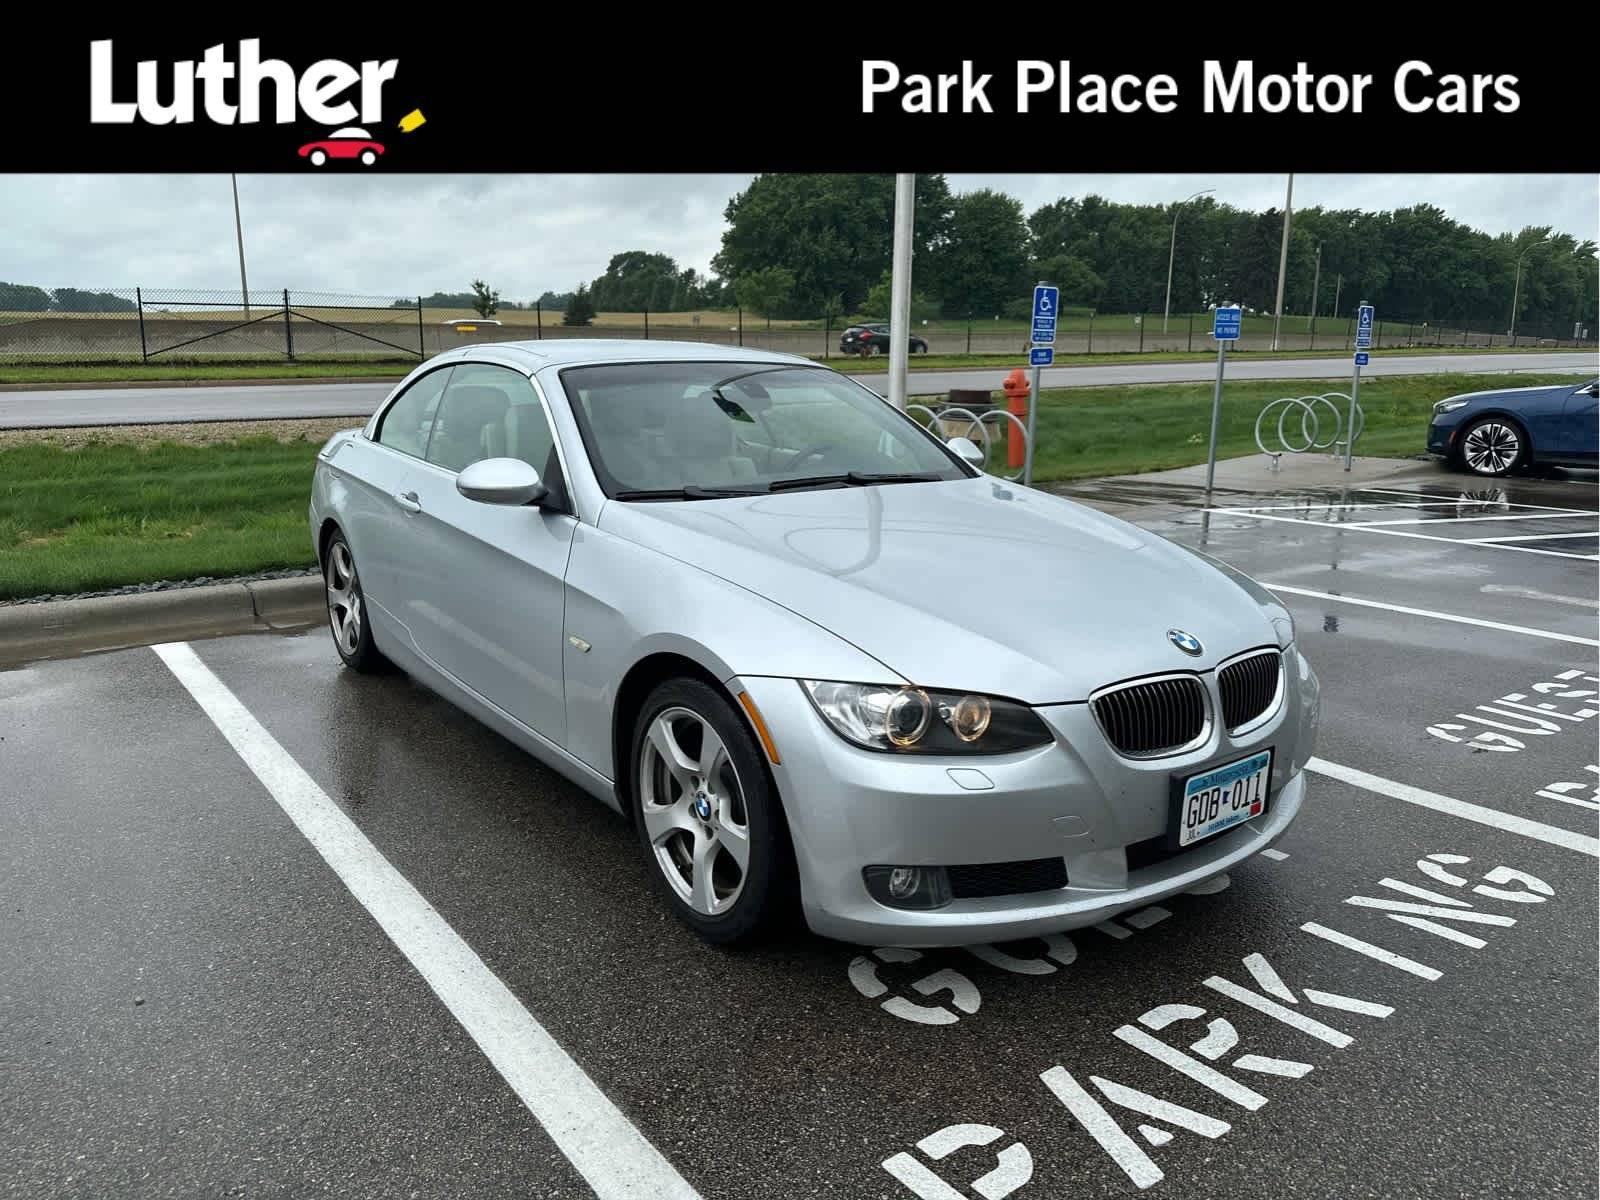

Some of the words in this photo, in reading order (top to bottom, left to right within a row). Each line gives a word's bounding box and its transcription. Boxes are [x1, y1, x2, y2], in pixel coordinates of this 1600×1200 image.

[1187, 786, 1221, 829] GDB
[1232, 772, 1261, 811] 011
[881, 853, 1556, 1200] PARKING
